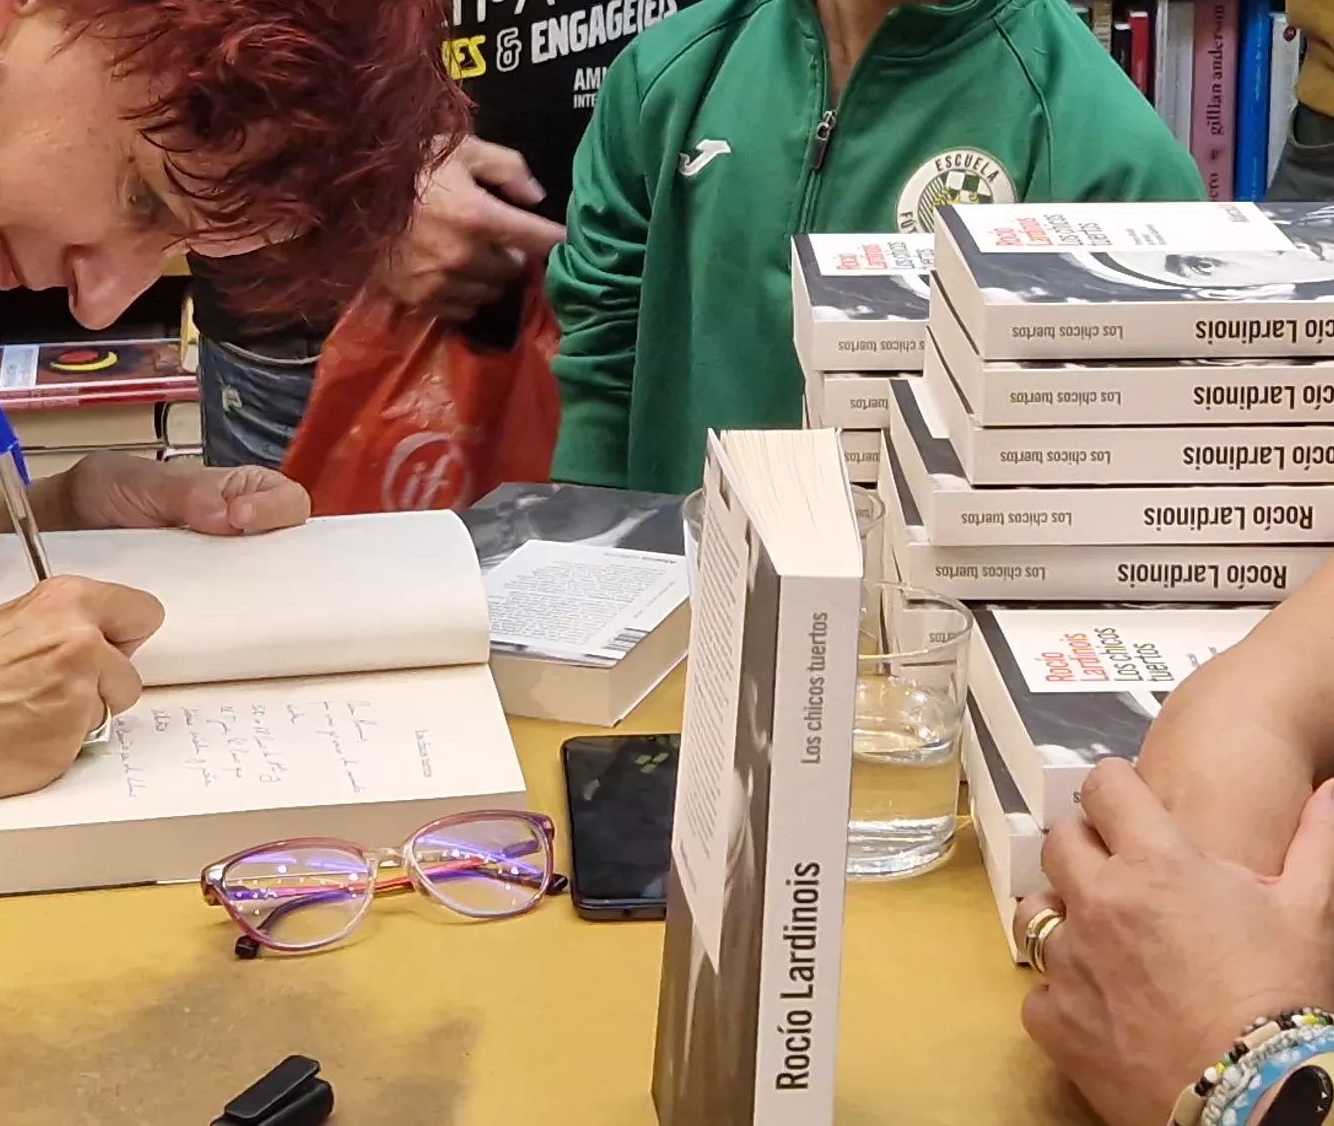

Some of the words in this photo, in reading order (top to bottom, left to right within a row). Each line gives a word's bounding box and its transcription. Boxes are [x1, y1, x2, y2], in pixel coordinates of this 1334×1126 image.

[1207, 4, 1225, 80] anderson
[1205, 83, 1224, 136] gillian
[934, 152, 1000, 183] ESCUELA
[1012, 323, 1056, 342] tuertos
[1059, 323, 1095, 342] chicos
[1098, 323, 1124, 342] Los
[1194, 316, 1299, 344] Lardinois
[837, 338, 878, 355] tuertos
[880, 338, 917, 355] chicos
[1010, 390, 1054, 408] tuertos
[1056, 390, 1093, 408] chicos
[1096, 390, 1122, 408] Los
[1193, 382, 1297, 411] Lardinois
[843, 449, 881, 465] uertos
[1000, 449, 1043, 466] tuertos
[1046, 449, 1083, 466] chicos
[1085, 449, 1112, 466] Los
[1182, 443, 1287, 471] Lardinois
[962, 511, 1005, 528] tuertos
[1008, 511, 1044, 528] chicos
[1046, 511, 1073, 528] Los
[1143, 503, 1247, 532] Lardinois
[1252, 503, 1314, 532] Rocío
[935, 564, 979, 581] tuertos
[982, 564, 1018, 581] chicos
[1019, 564, 1046, 581] Los
[1116, 561, 1220, 590] Lardinois
[1225, 561, 1287, 590] Rocío
[805, 613, 829, 675] tuertos
[1035, 651, 1077, 683] Rocío
[801, 676, 825, 735] chicos
[799, 735, 822, 767] Los
[779, 862, 821, 1001] Lardinois
[775, 1011, 813, 1093] Rocío
